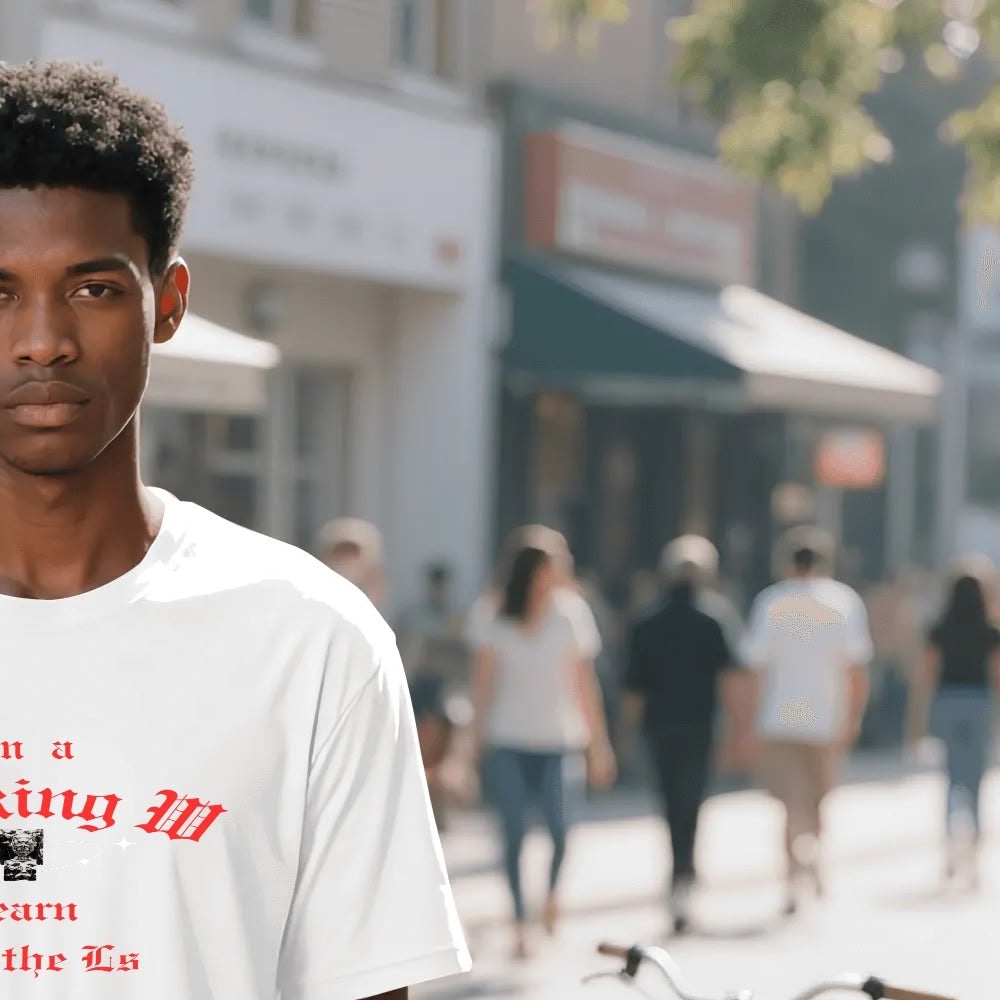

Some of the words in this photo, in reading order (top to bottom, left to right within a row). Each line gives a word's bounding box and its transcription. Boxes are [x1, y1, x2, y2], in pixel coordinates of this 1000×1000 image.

[51, 740, 74, 760] a
[134, 789, 228, 843] W
[1, 944, 67, 978] the
[81, 944, 140, 973] Ls
